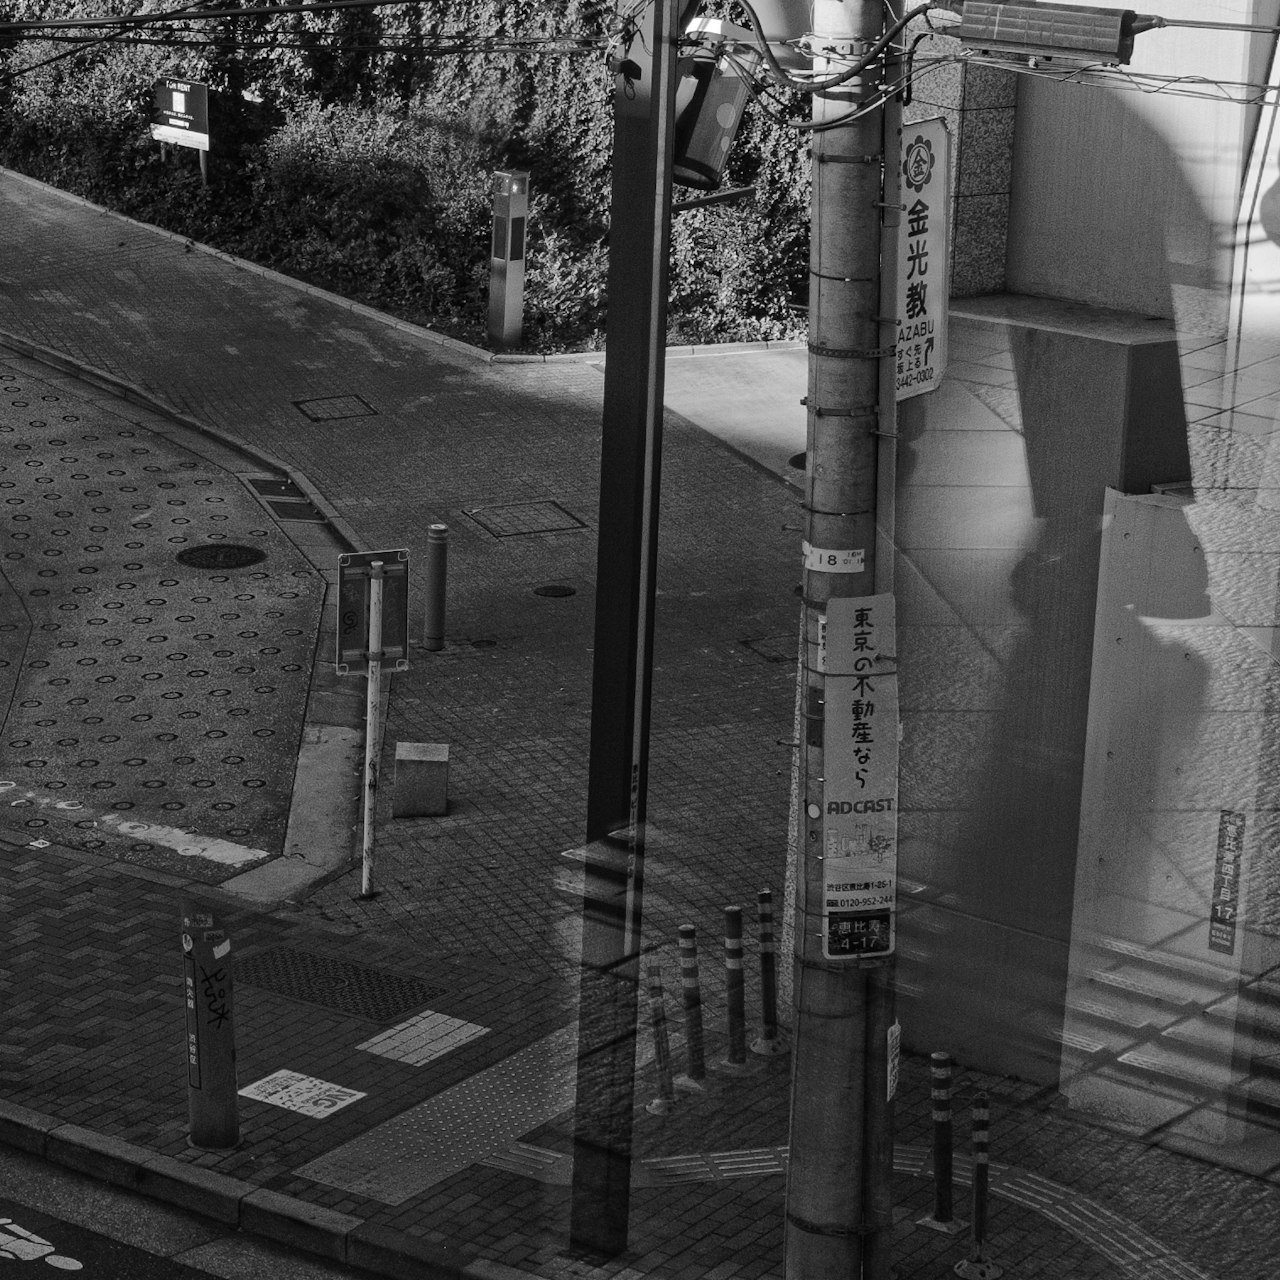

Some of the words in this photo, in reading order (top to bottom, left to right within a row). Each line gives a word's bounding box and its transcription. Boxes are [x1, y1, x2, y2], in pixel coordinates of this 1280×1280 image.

[906, 198, 929, 320] 金光教
[897, 320, 934, 344] AZABU
[851, 607, 875, 789] 東京の不動産なら
[827, 798, 894, 815] ADCAST
[840, 895, 893, 908] 0120-952-244
[1215, 904, 1234, 919] 17
[841, 936, 878, 951] 4-17
